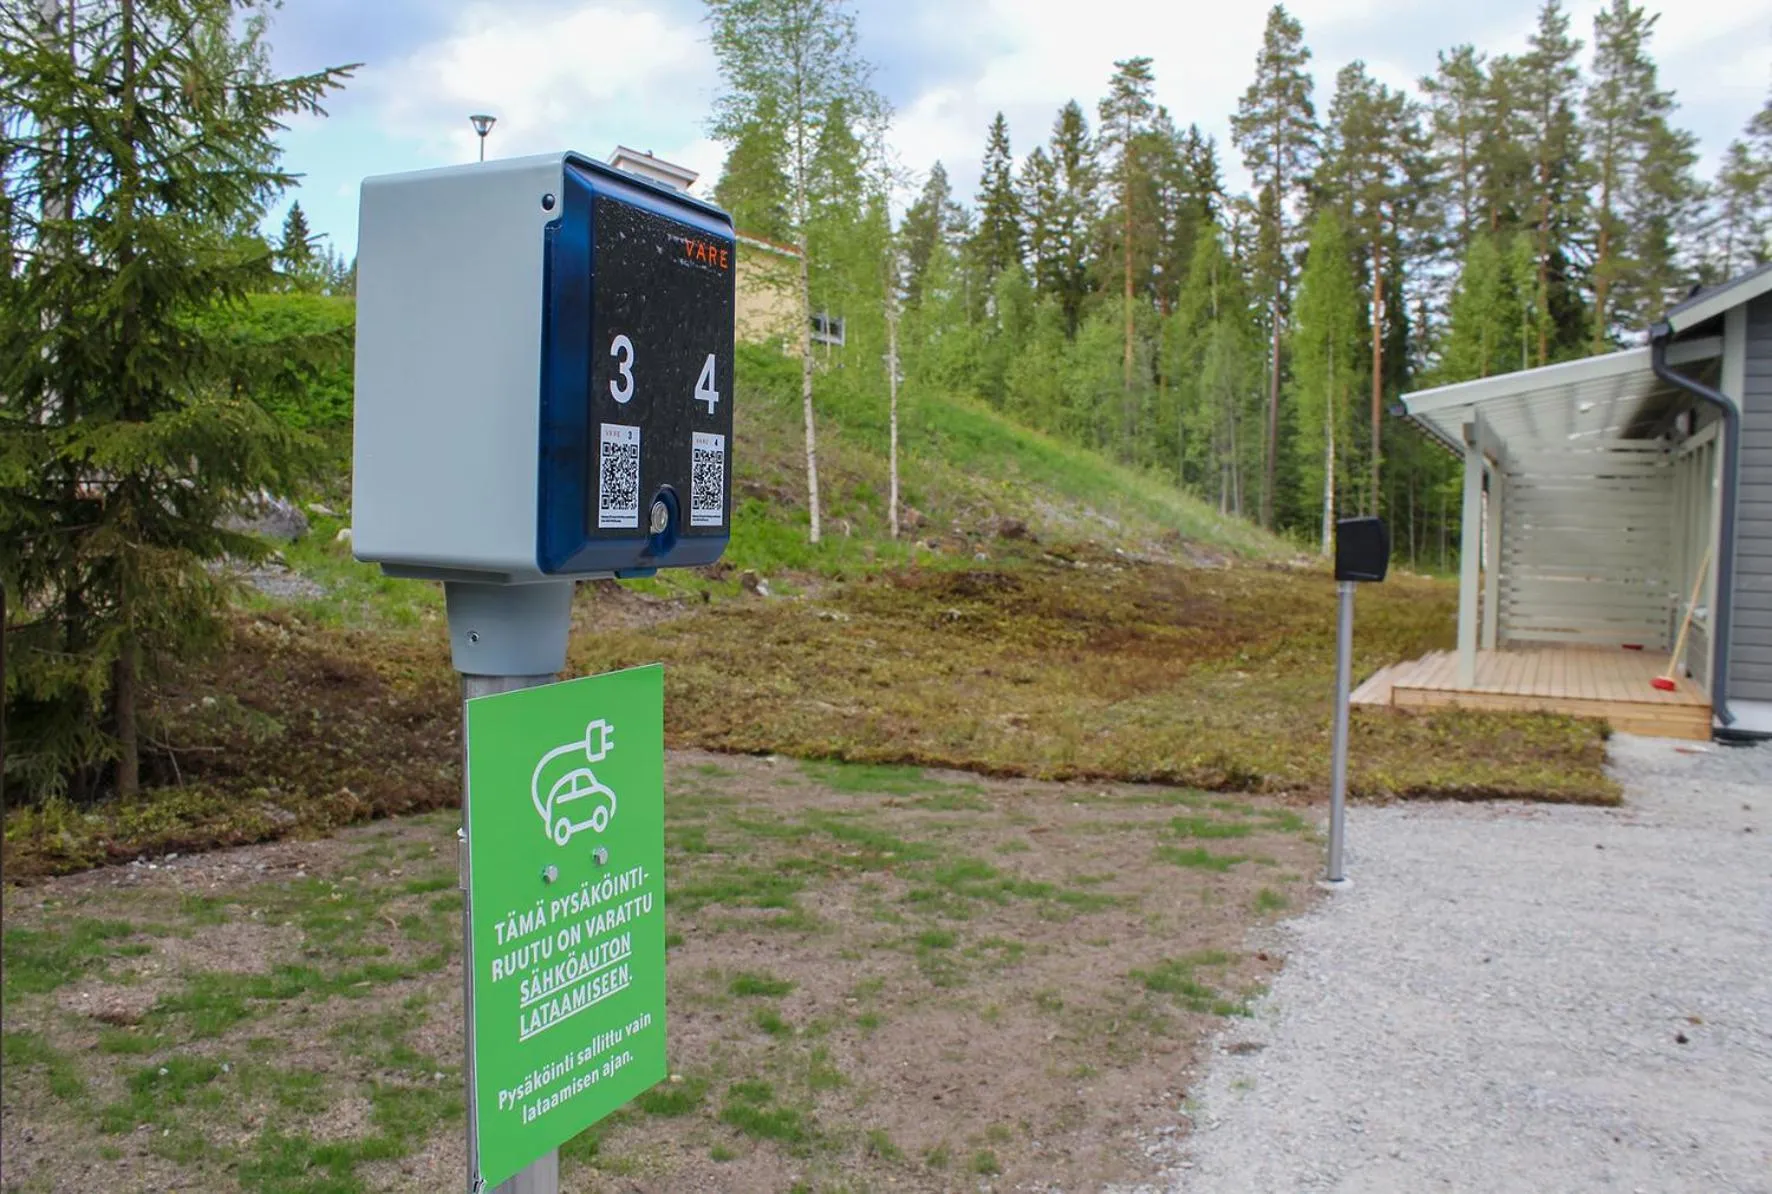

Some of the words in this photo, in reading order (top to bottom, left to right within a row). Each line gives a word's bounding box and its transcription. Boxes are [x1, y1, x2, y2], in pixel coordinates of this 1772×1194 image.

[609, 334, 635, 404] 3
[694, 353, 720, 415] 4
[627, 430, 633, 440] 3
[491, 936, 553, 983] RUUTU
[558, 924, 581, 951] ON
[586, 892, 653, 938] VARATTU
[494, 899, 547, 946] TÄMÄ
[551, 866, 649, 922] PYSÄKÖINTI-
[519, 932, 632, 1006] SÄHKÖAUTON
[519, 963, 633, 1039] LATAAMISEEN.
[498, 1053, 575, 1111] Pysäköinti
[577, 1030, 622, 1066] sallittu
[625, 1012, 652, 1037] vain
[522, 1069, 600, 1125] lataamisen
[602, 1050, 633, 1078] ajan.
